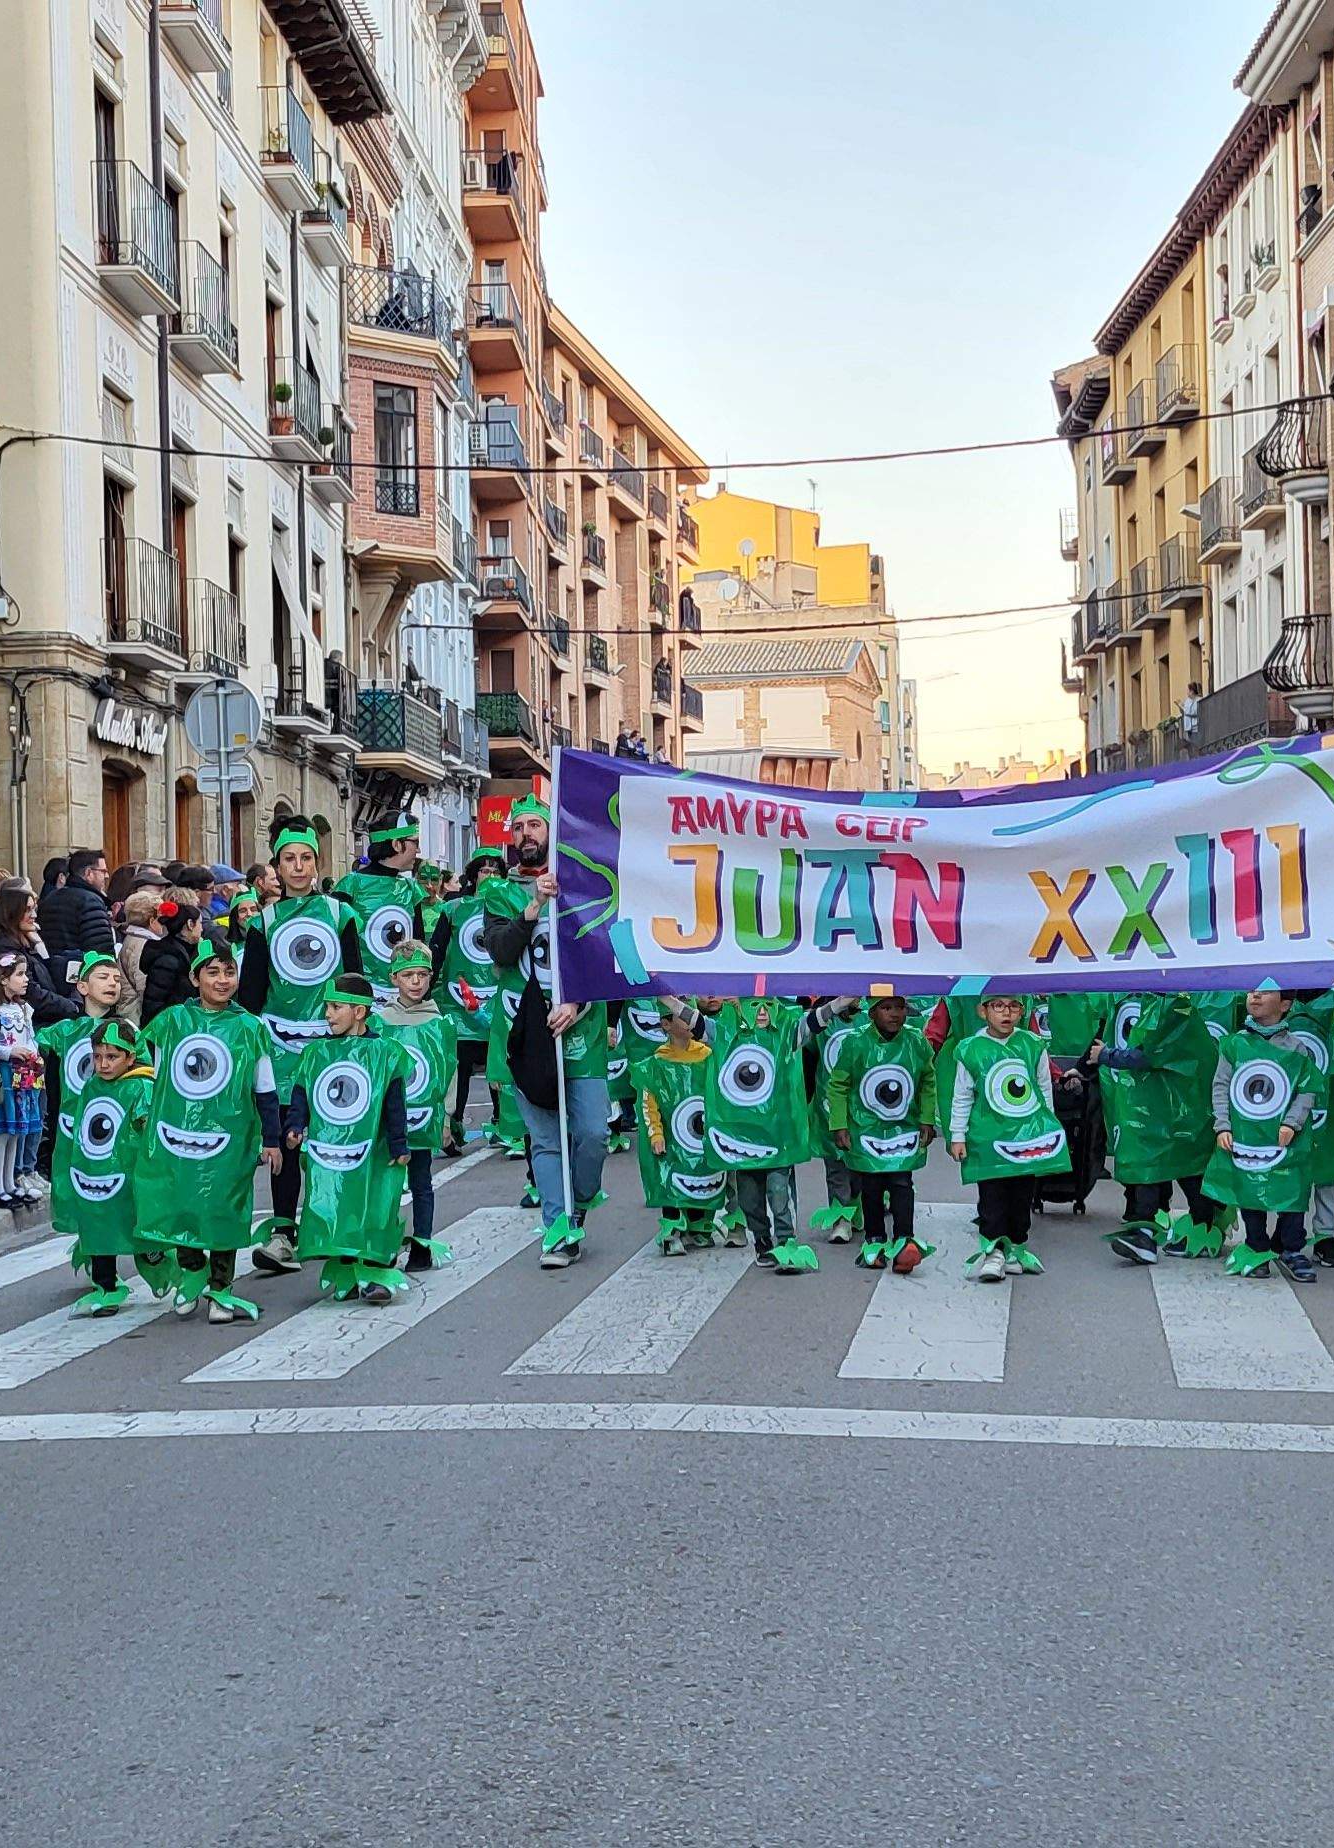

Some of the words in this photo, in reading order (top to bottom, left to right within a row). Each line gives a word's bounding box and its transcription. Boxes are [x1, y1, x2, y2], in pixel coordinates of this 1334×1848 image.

[668, 792, 809, 840] AMYPA
[834, 812, 929, 844] CEIP
[652, 844, 965, 956] JUAN
[1028, 822, 1311, 963] XXIII
